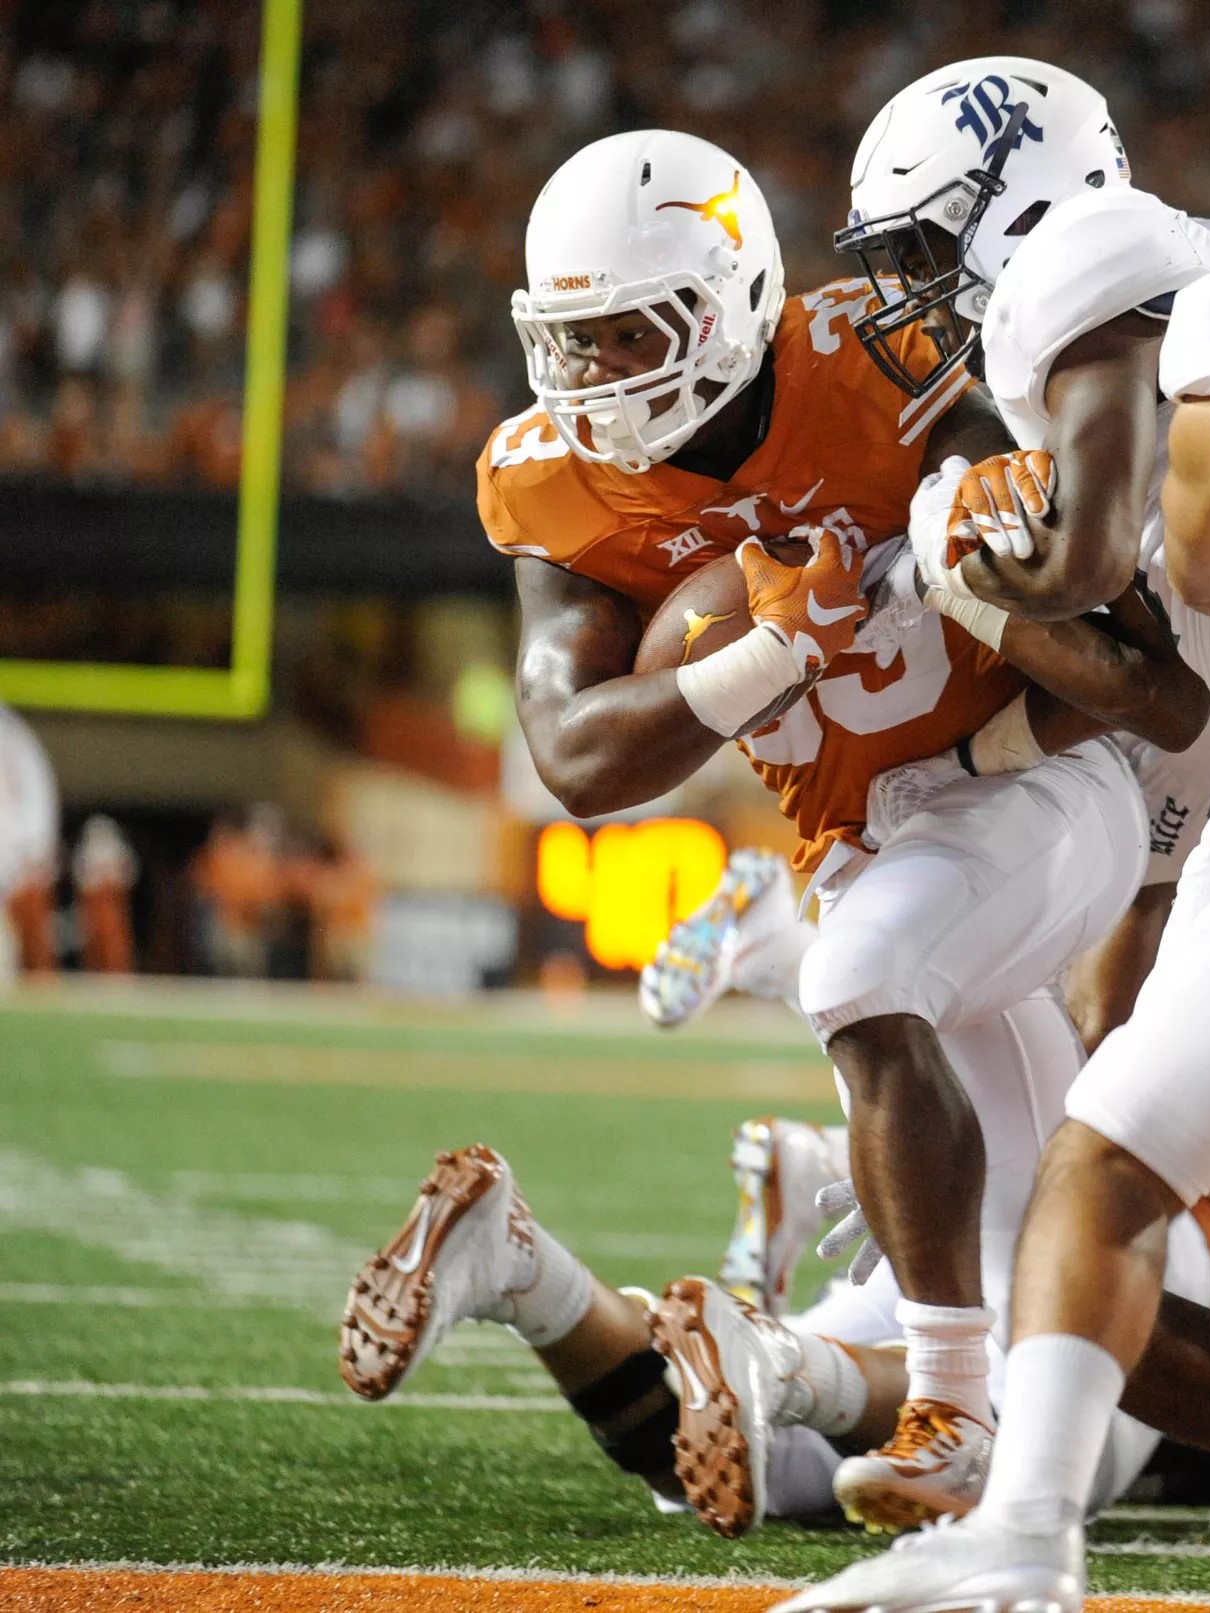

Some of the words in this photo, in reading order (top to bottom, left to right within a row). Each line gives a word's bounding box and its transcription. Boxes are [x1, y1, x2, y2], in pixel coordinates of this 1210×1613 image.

[552, 274, 591, 291] HORNS
[656, 526, 713, 567] XII
[1150, 795, 1191, 857] Rice
